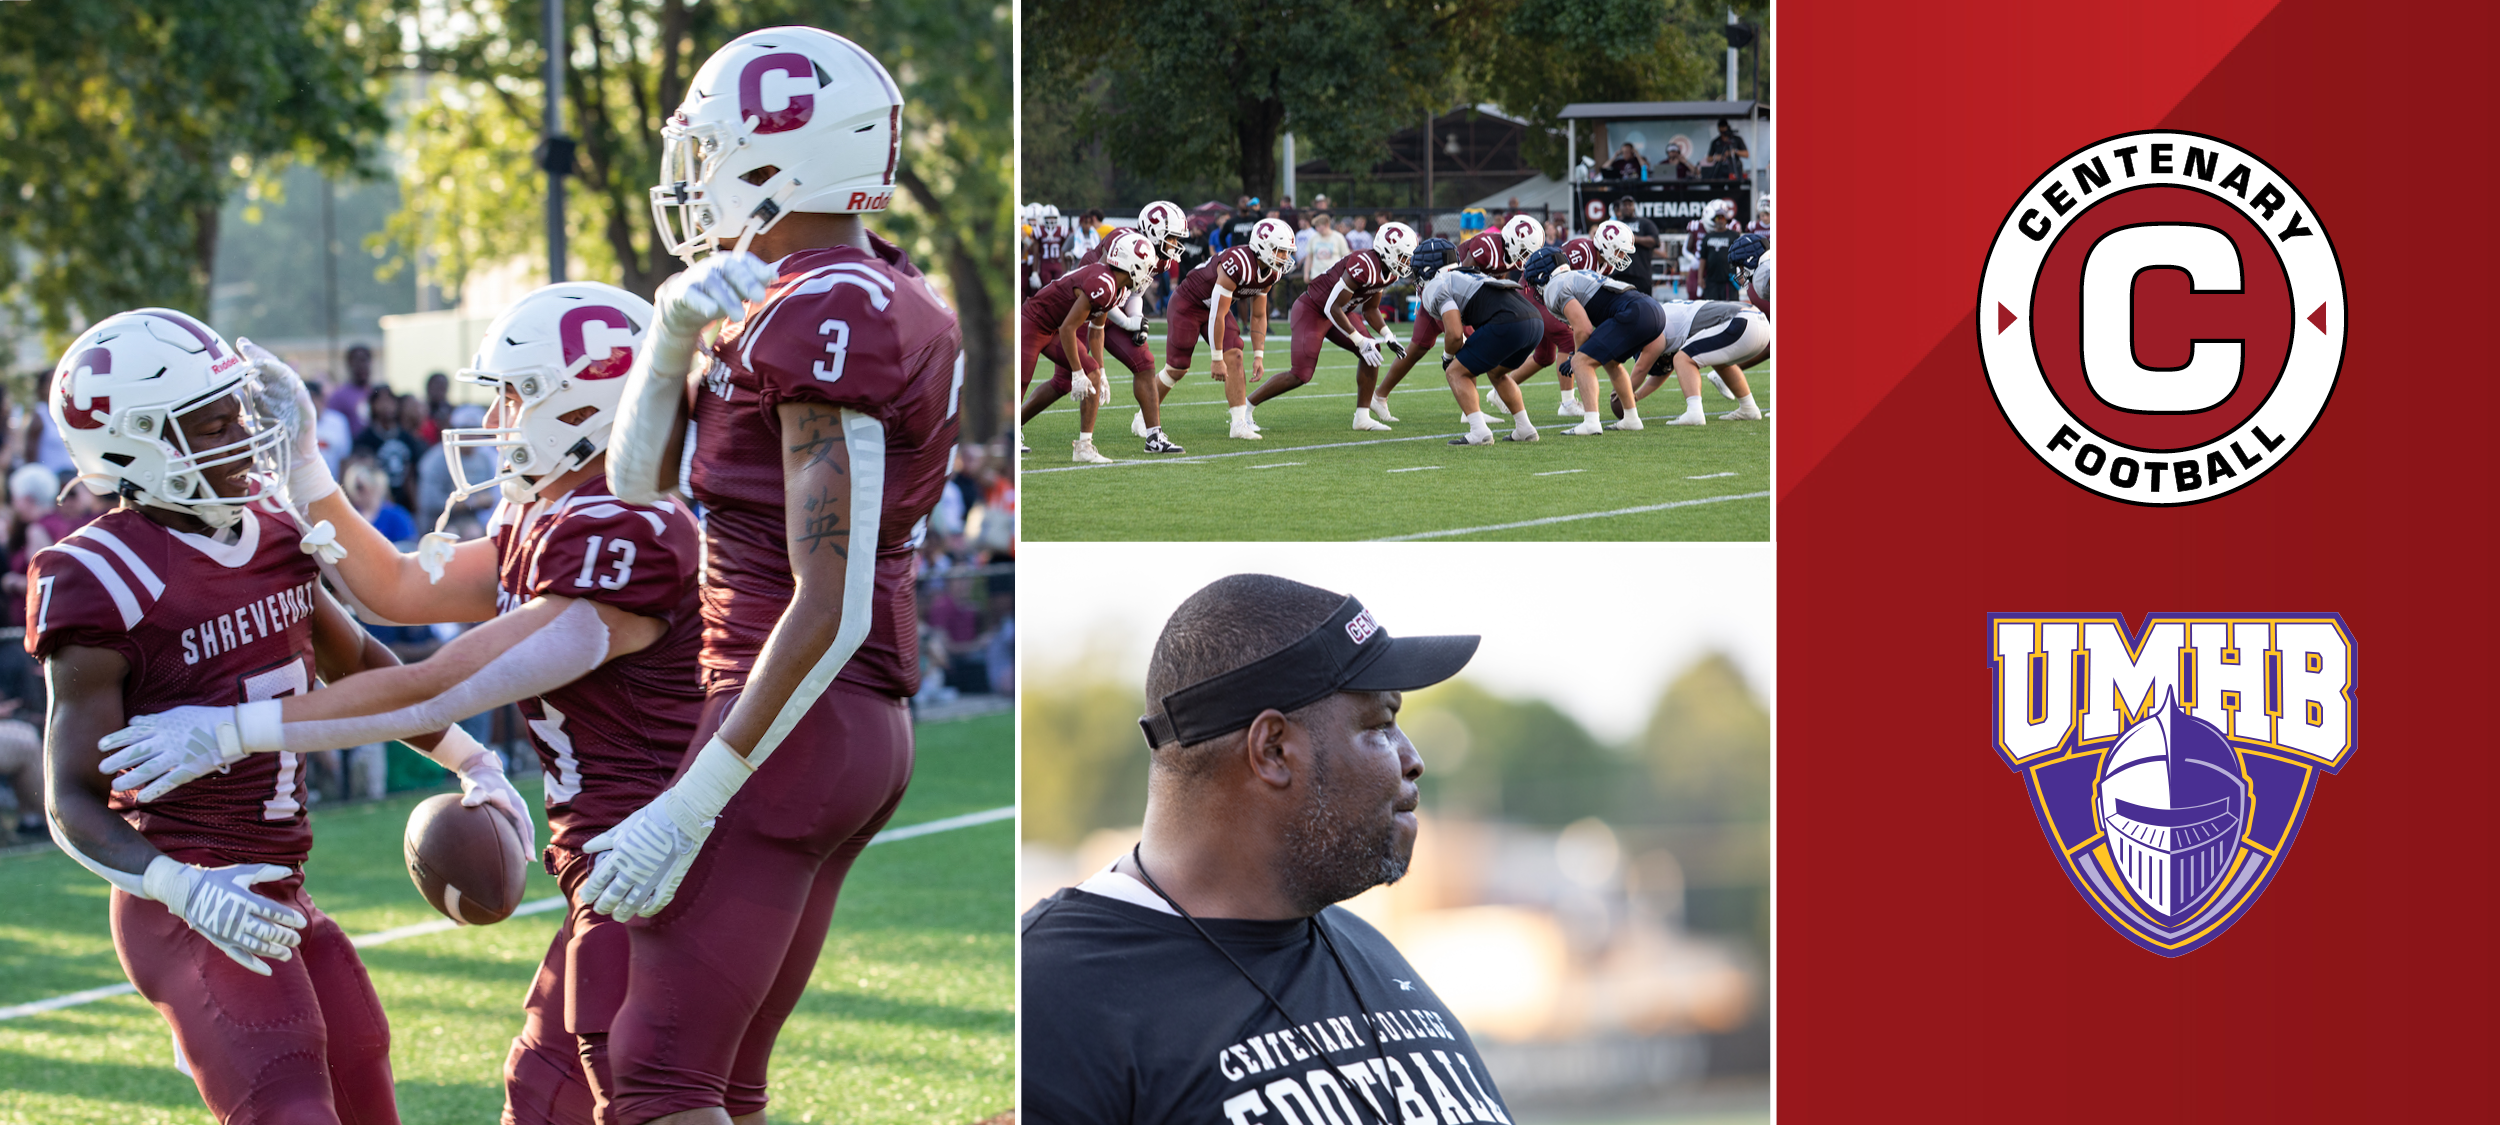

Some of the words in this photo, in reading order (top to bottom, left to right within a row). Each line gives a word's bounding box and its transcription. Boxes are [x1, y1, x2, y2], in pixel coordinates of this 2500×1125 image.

[739, 53, 815, 135] C
[1148, 205, 1168, 225] C
[1588, 204, 1603, 219] C
[1608, 201, 1708, 218] NTENAR
[1256, 222, 1275, 241] C
[1384, 227, 1404, 245] C
[1514, 221, 1534, 239] C
[1602, 225, 1620, 242] C
[1472, 247, 1485, 259] 0
[1568, 249, 1583, 265] 46
[1221, 256, 1238, 276] 26
[1348, 262, 1364, 278] 14
[1090, 286, 1105, 300] 3
[559, 304, 634, 381] C
[812, 318, 851, 384] 3
[573, 535, 637, 591] 13
[36, 575, 56, 634] 7
[181, 580, 315, 666] SHREVEPORT
